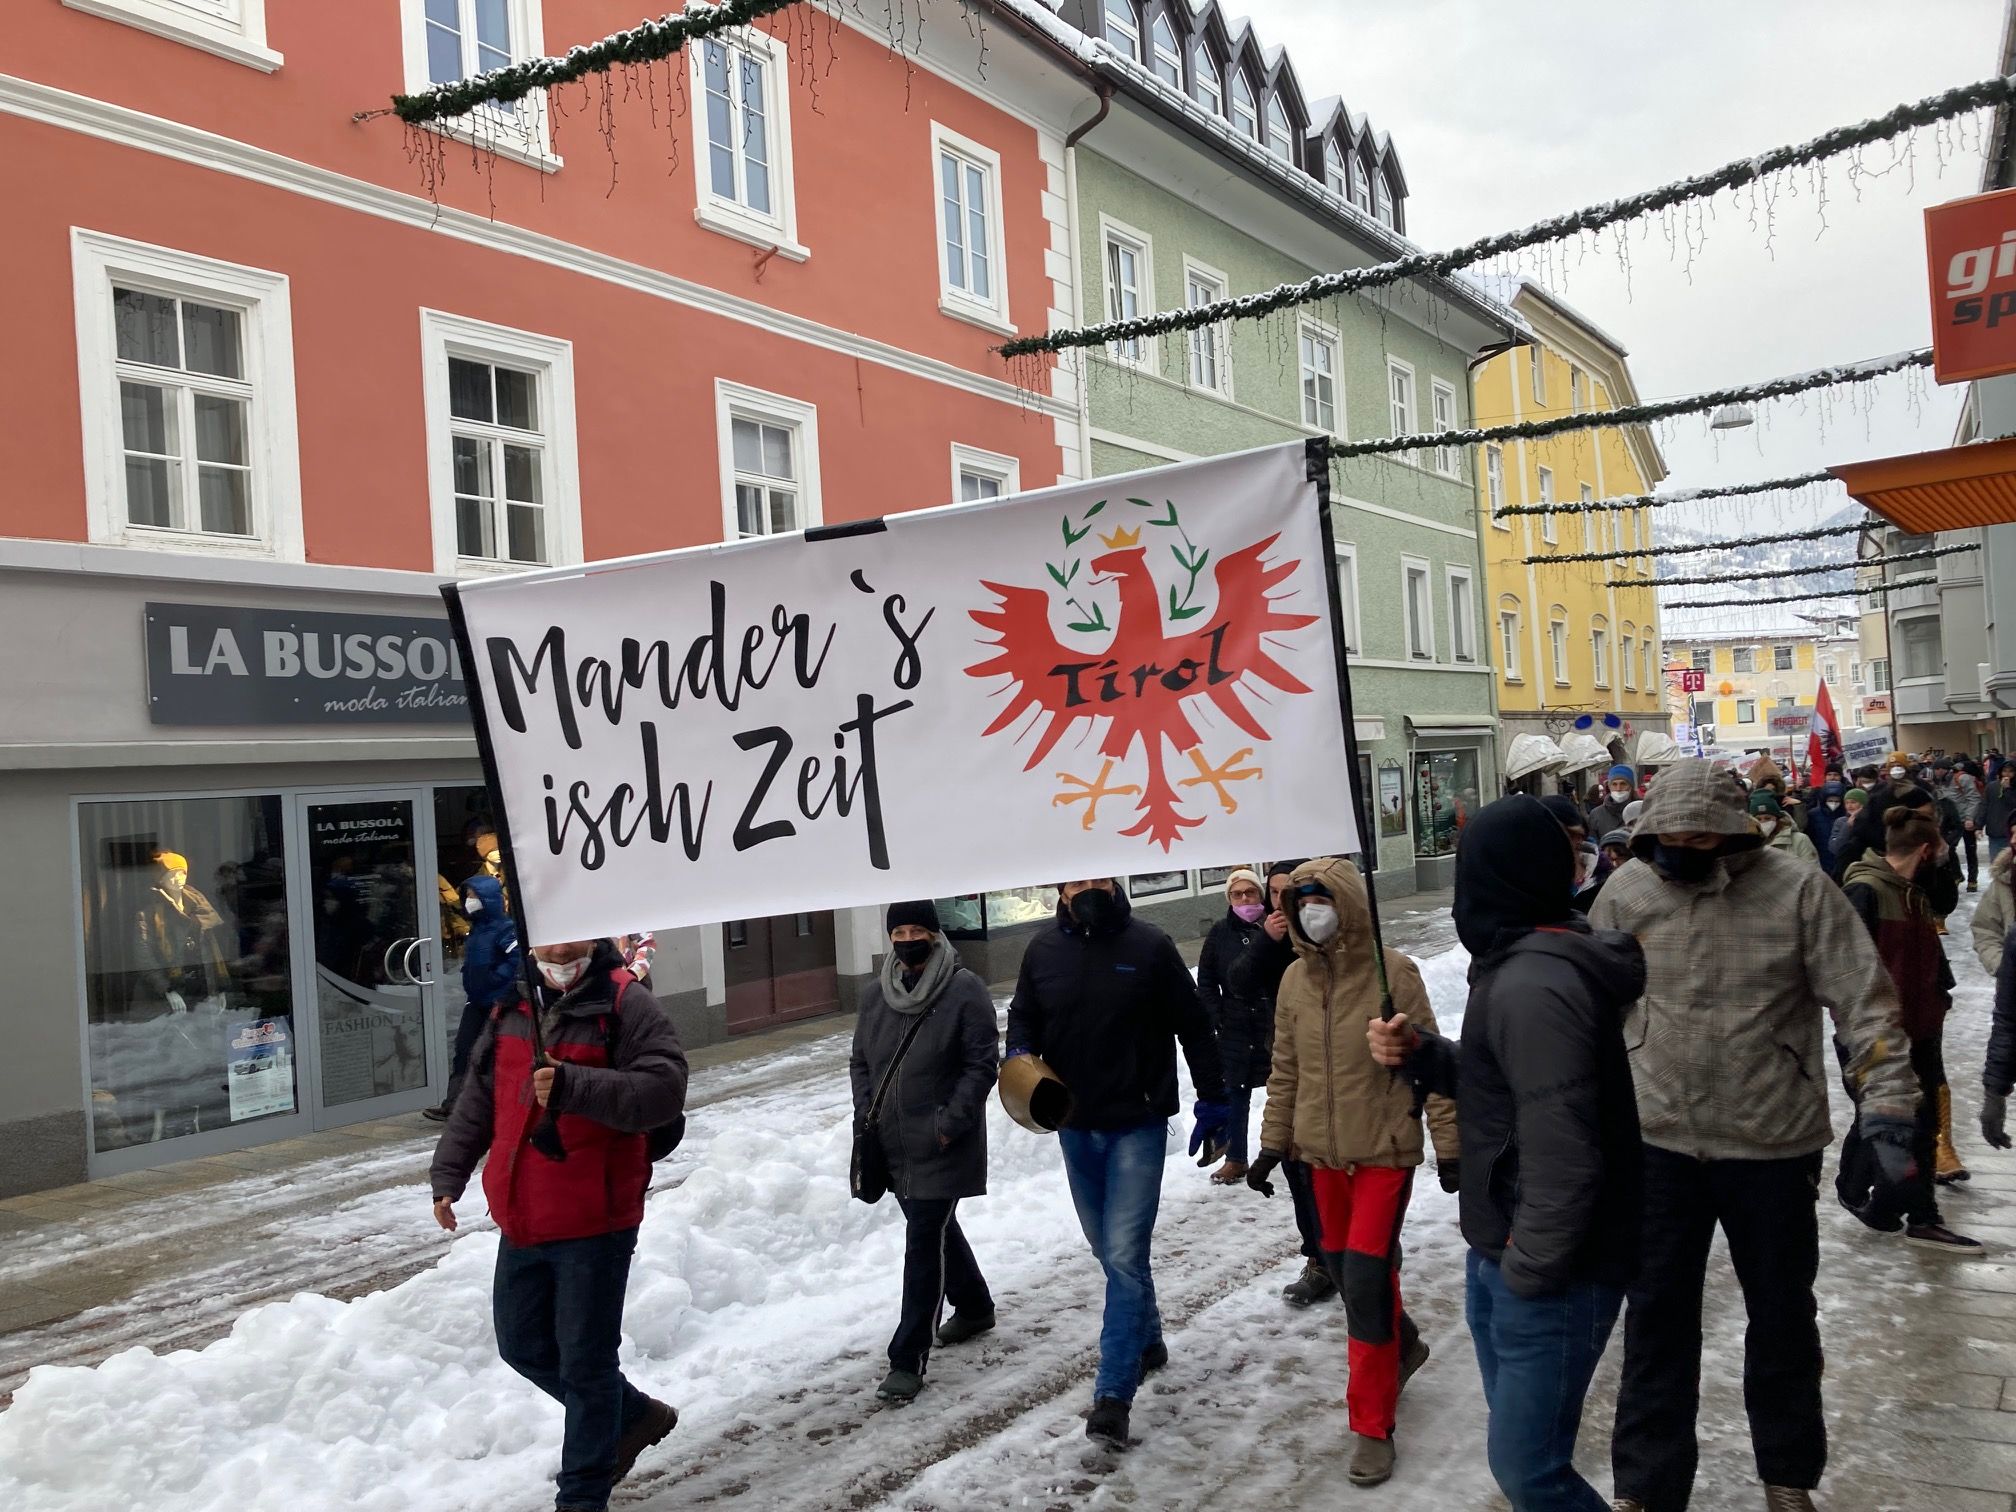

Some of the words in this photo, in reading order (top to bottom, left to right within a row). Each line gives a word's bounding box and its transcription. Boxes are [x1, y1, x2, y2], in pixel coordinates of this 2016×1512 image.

[169, 625, 249, 676] LA
[1047, 621, 1235, 707] Tirol
[324, 686, 389, 713] moda
[1869, 699, 1886, 709] dm
[543, 721, 712, 870] isch
[732, 693, 914, 870] Zeit
[316, 822, 336, 832] LA
[339, 818, 404, 830] BUSSOLA
[322, 832, 352, 845] moda
[354, 830, 399, 842] italiana
[325, 1015, 394, 1036] FASHION
